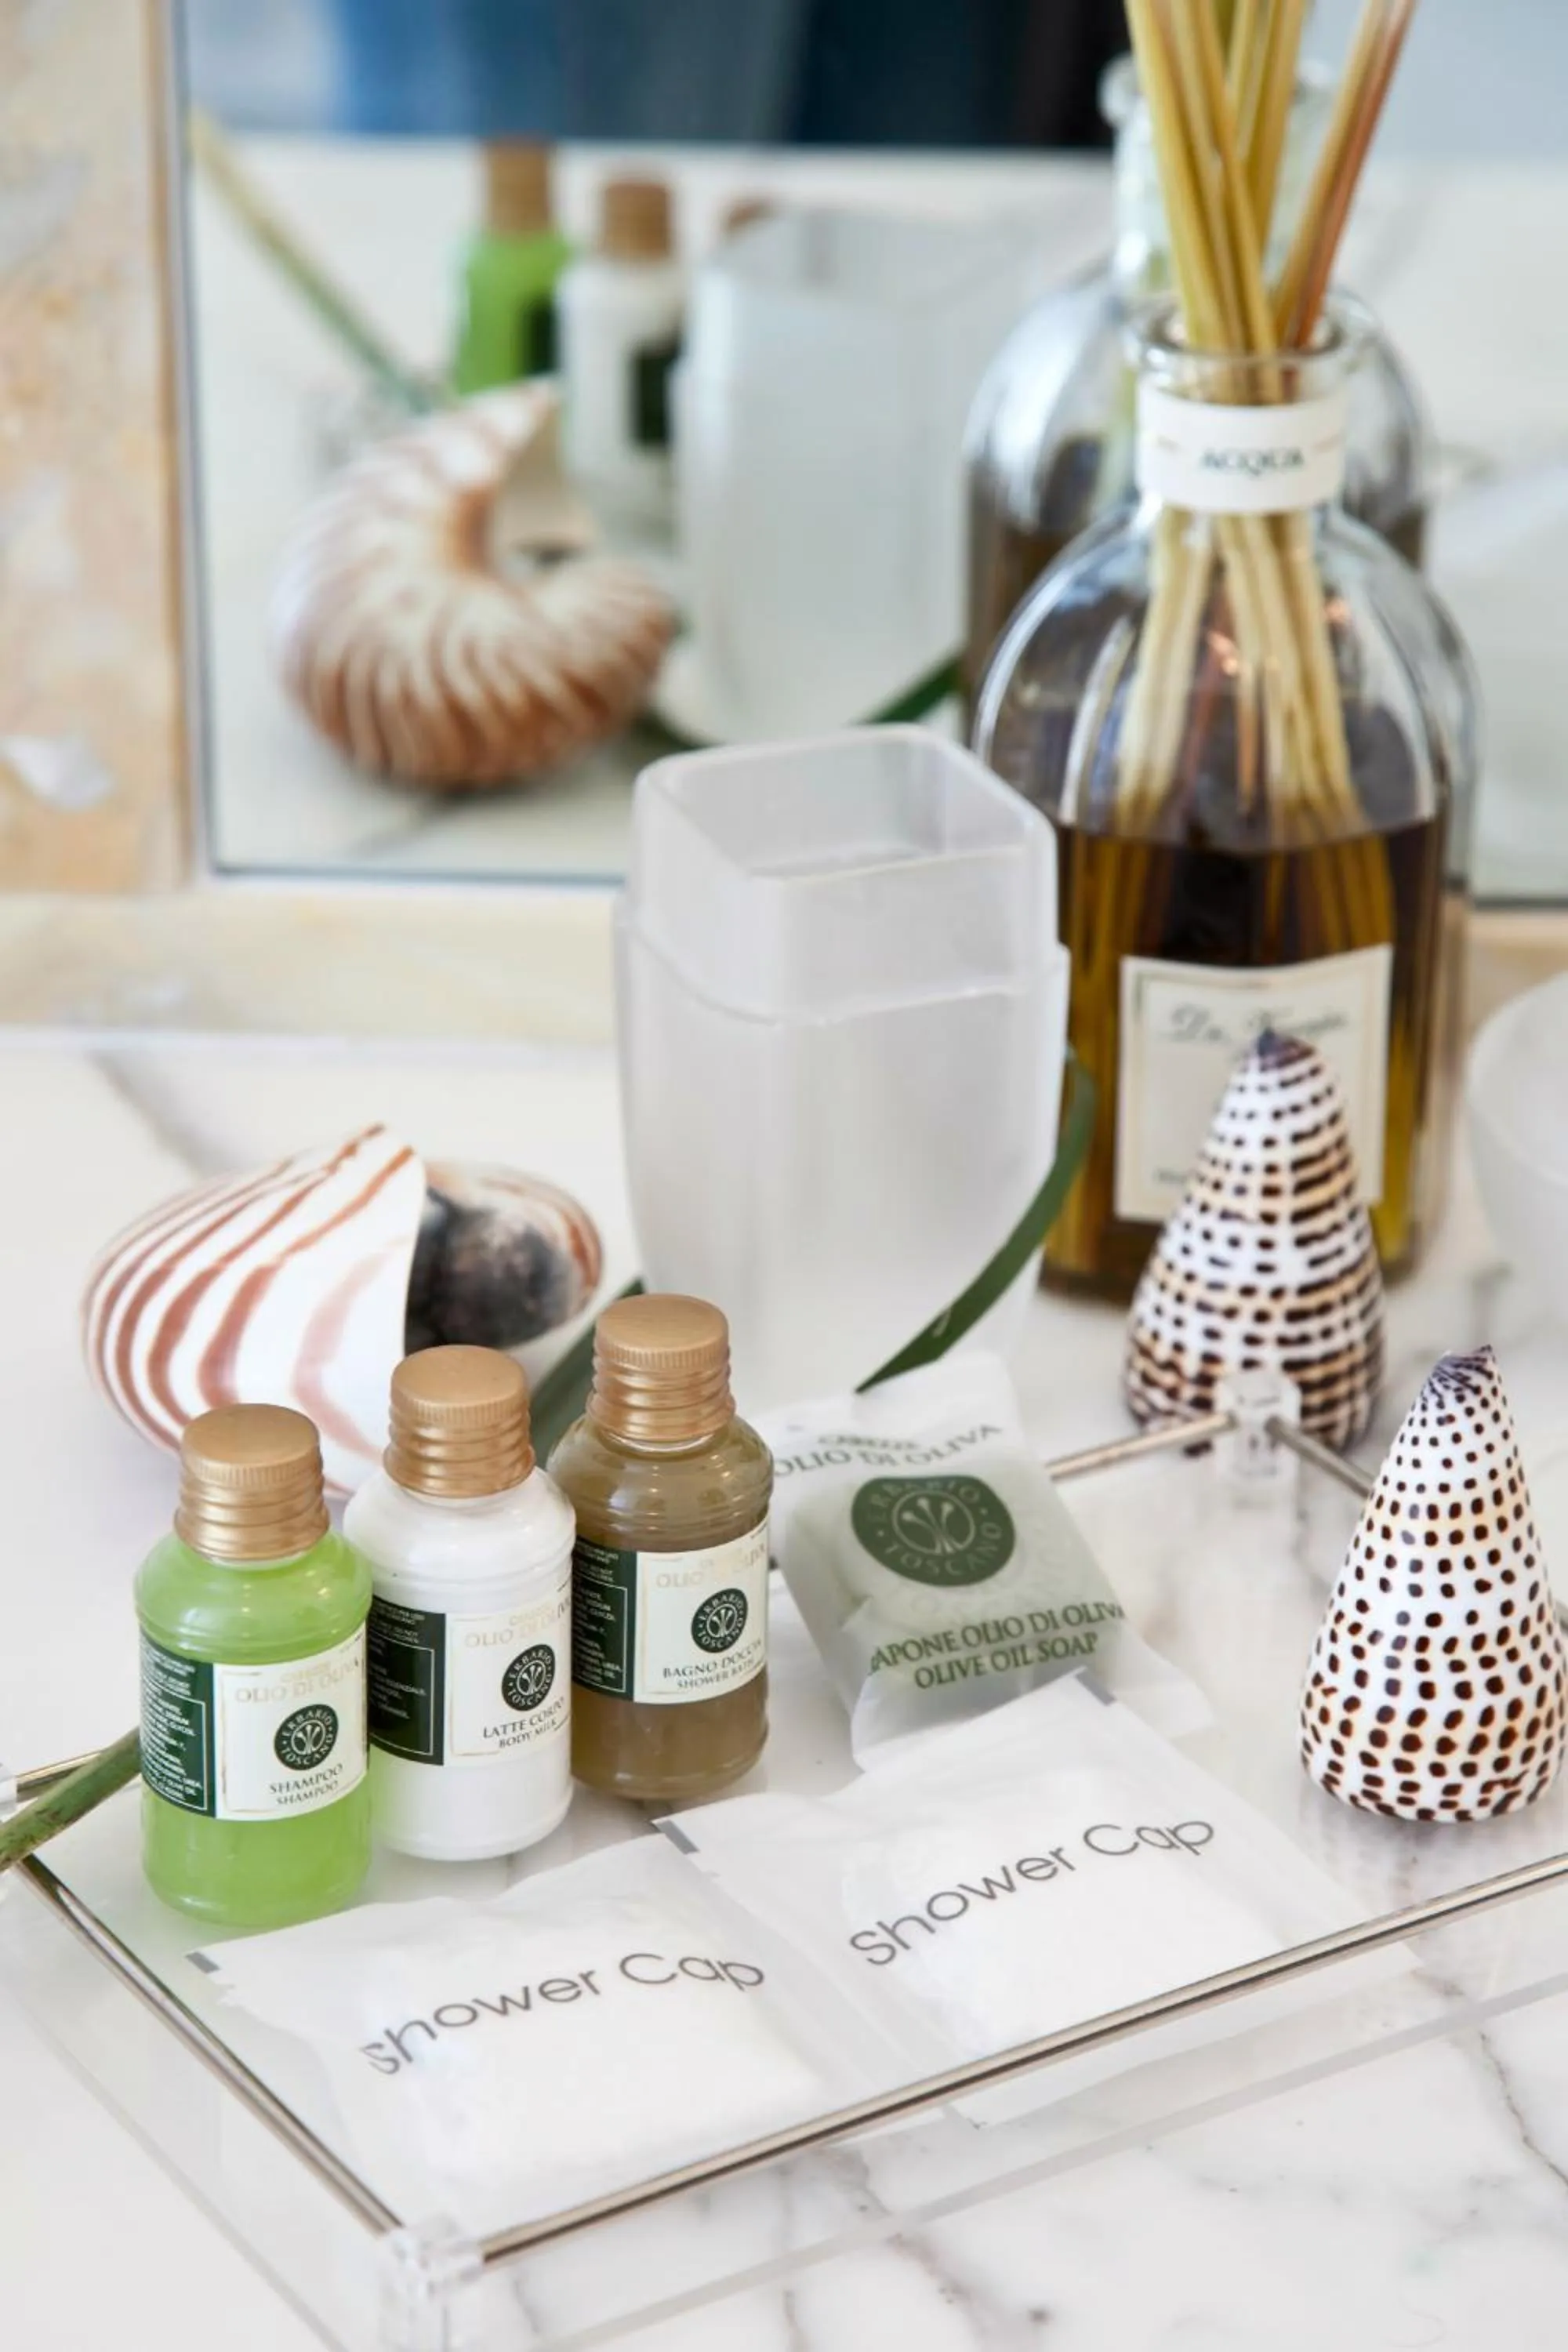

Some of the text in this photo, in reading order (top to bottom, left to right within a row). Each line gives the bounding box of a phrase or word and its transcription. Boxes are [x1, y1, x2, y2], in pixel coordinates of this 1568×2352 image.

[774, 1449, 851, 1476] OLIO
[904, 1423, 1003, 1465] OLIVA
[960, 1616, 1025, 1648] OLIO
[1028, 1610, 1062, 1635] DI
[663, 1661, 719, 1679] BAGNO
[914, 1632, 1098, 1690] OLIVE OIL SOAP
[677, 1671, 730, 1689] SHOWER
[234, 1686, 287, 1703] OLIO
[483, 1719, 527, 1739] LATTE
[499, 1731, 532, 1749] BODY
[270, 1762, 343, 1794] SHAMPOO
[276, 1780, 338, 1805] SHAMPOO
[1083, 1820, 1214, 1857] Cap
[619, 1952, 765, 1991] Cap
